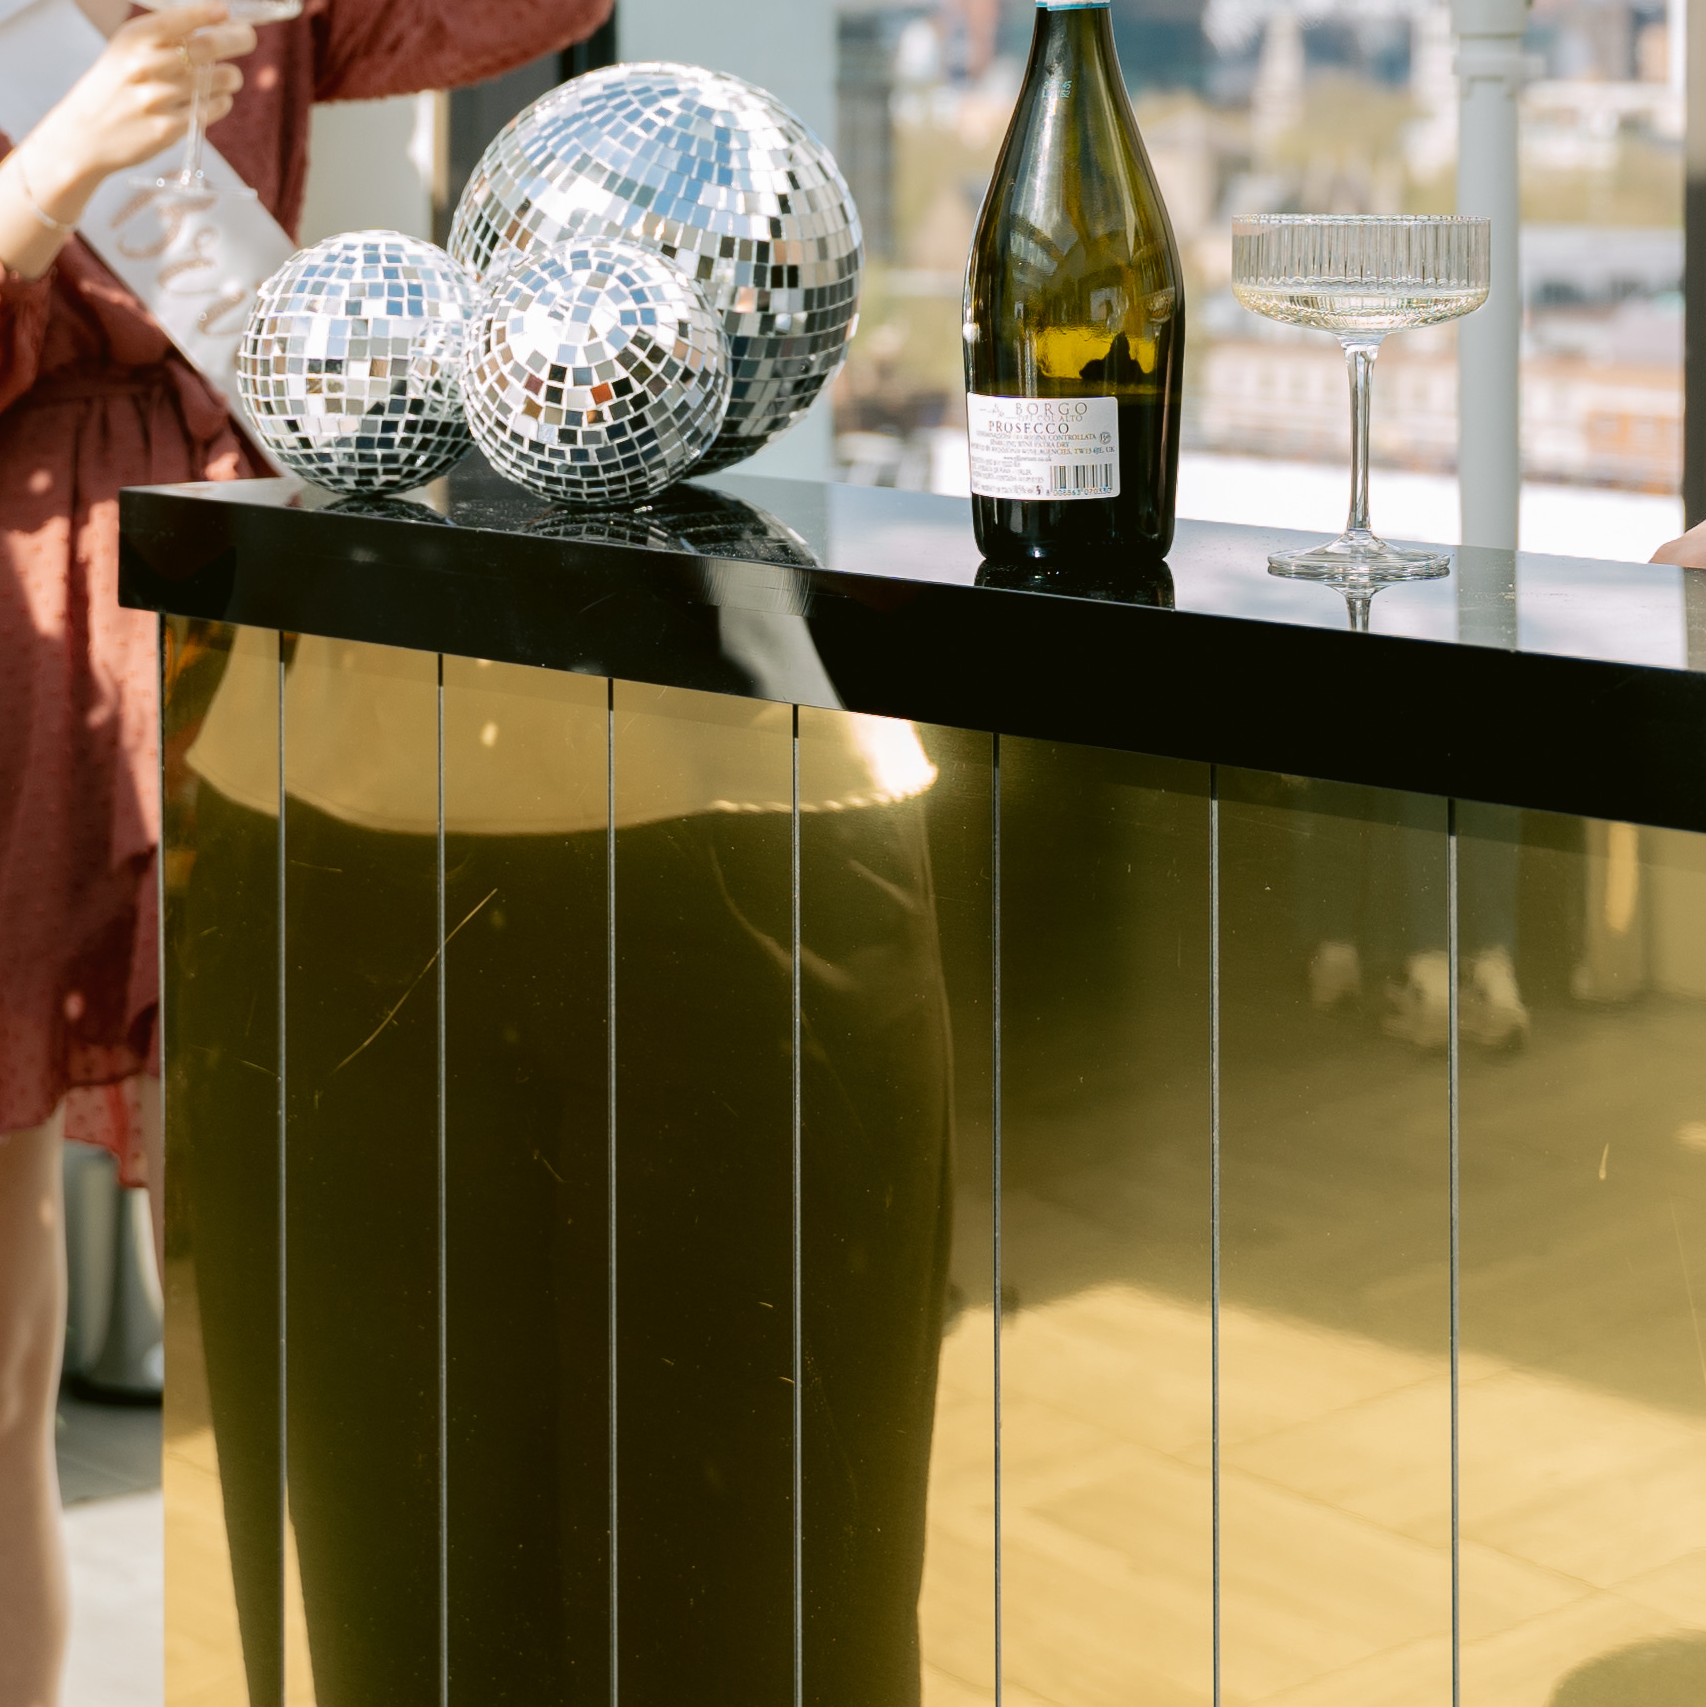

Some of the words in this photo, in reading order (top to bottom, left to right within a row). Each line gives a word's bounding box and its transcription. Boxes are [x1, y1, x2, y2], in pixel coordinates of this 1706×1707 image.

[1015, 402, 1088, 415] BORGO
[1059, 415, 1083, 423] ALTO
[988, 420, 1069, 434] PROSECCO
[1048, 433, 1096, 441] CONTROLLATA
